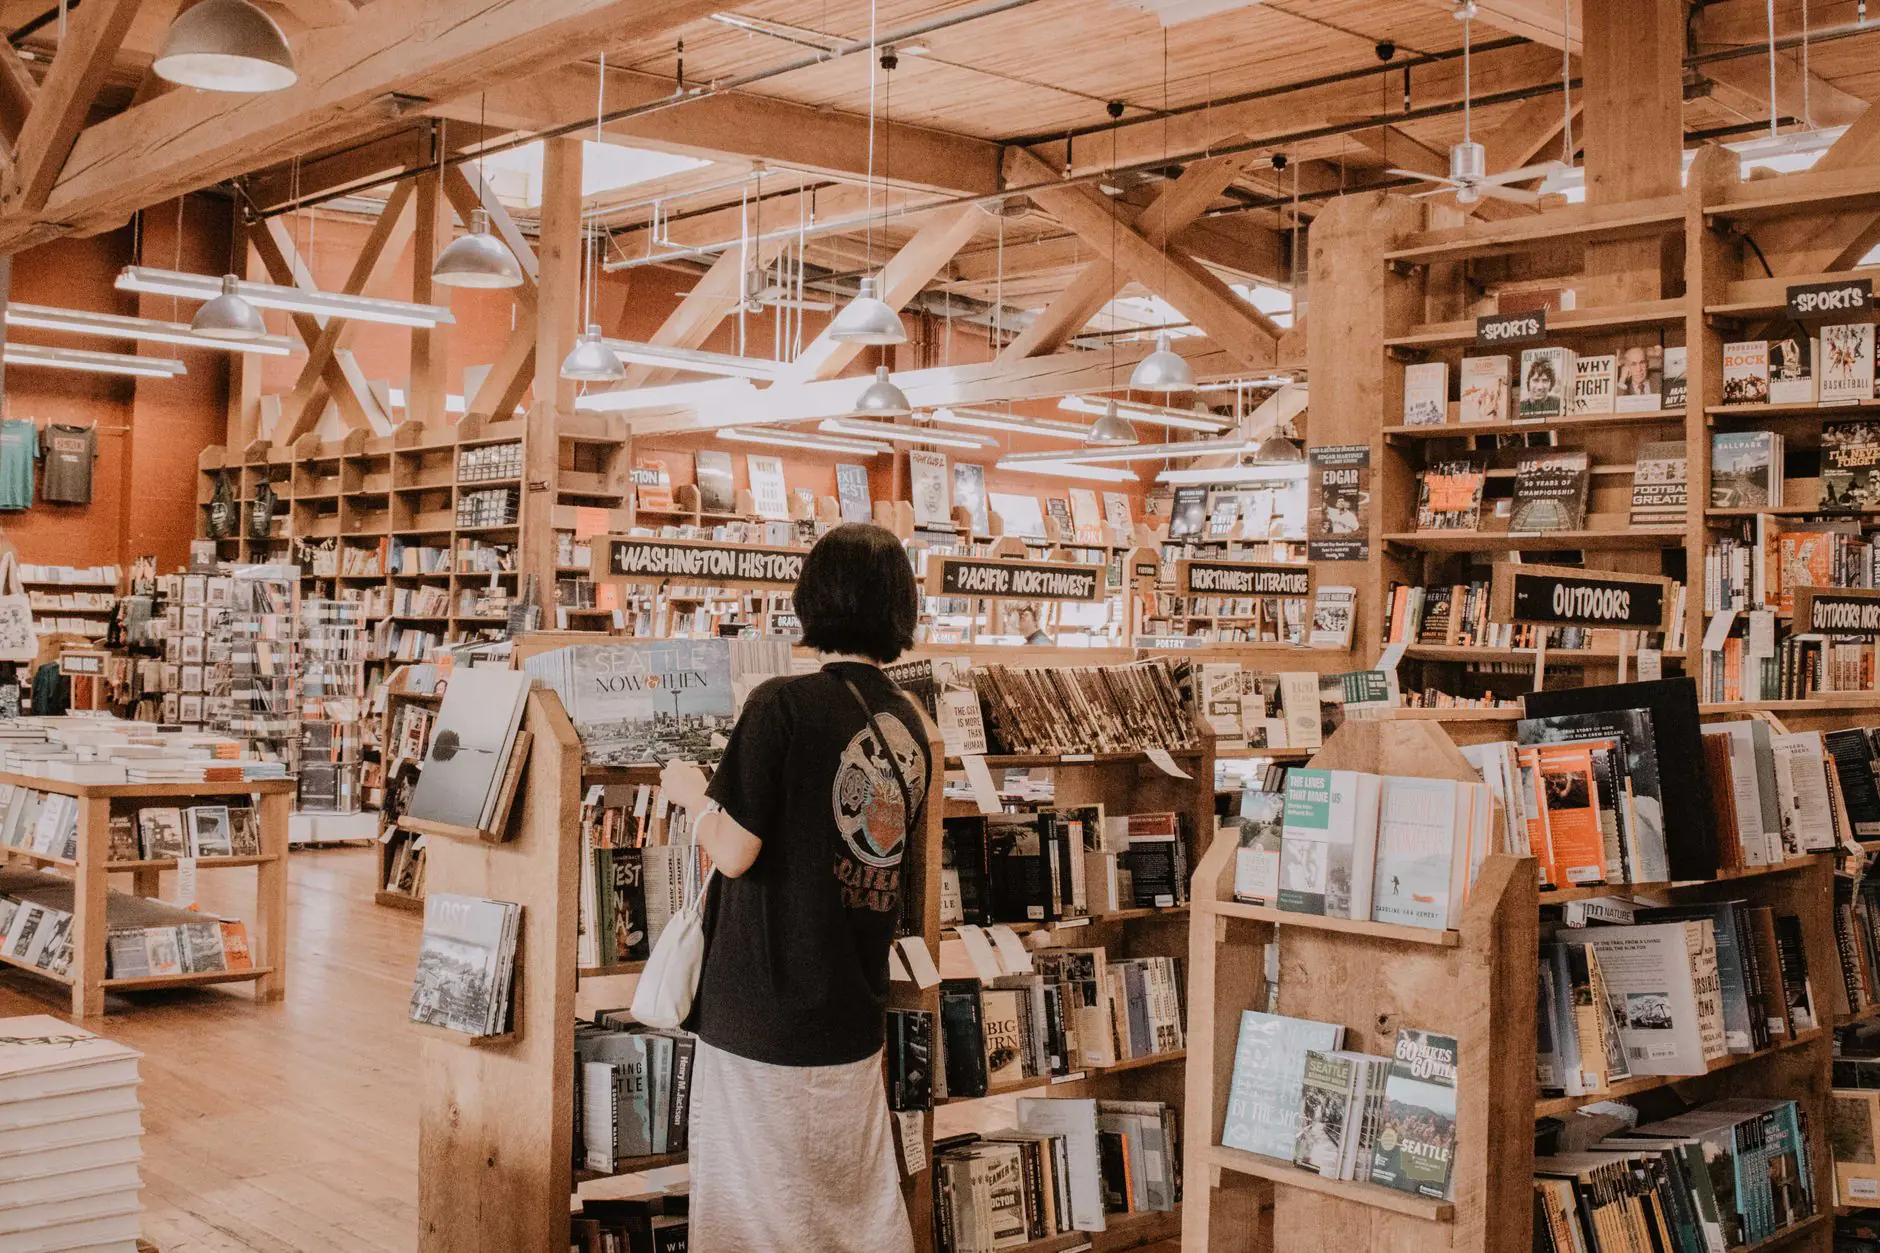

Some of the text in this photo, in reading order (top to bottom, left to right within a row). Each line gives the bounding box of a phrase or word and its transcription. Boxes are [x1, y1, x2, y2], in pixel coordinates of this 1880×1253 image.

[1797, 288, 1864, 312] SPORTS
[1485, 318, 1539, 340] SPORTS
[1577, 360, 1610, 373] WHY
[1724, 355, 1765, 367] ROCK
[1576, 378, 1610, 396] FIGHT
[1823, 379, 1869, 390] BASKETBALL
[1718, 441, 1762, 450] BALLPARK
[1851, 447, 1880, 458] NEVE
[1521, 459, 1580, 472] US OPEN
[1837, 457, 1876, 467] FORGET
[629, 469, 659, 484] TION
[1323, 469, 1359, 485] EDGAR
[620, 545, 735, 575] WASHINGTON
[958, 567, 1091, 597] PACIFIC NORTHWEST
[1191, 568, 1309, 593] NORTHWEST LITERATURE
[1553, 583, 1630, 620] OUTDOORS
[1814, 600, 1880, 629] OUTDOORS NOR
[1156, 639, 1185, 648] POETRY
[594, 649, 709, 676] SEATTLE
[596, 673, 641, 694] NOW
[661, 671, 708, 690] THEN
[954, 705, 979, 715] THE CITY
[957, 716, 981, 727] IS MORE
[968, 728, 983, 738] THAN
[963, 739, 984, 750] HUMAN
[1290, 775, 1303, 787] THE
[1289, 789, 1307, 801] THAT
[1308, 791, 1328, 802] MAKE
[1604, 907, 1633, 921] NATURE
[987, 1020, 1016, 1035] BIG
[1396, 1039, 1453, 1063] 60 HIKES
[677, 1056, 688, 1079] Henry
[1309, 1061, 1349, 1079] SEATTLE
[1411, 1058, 1431, 1079] 60
[674, 1093, 685, 1126] Jackson
[1400, 1138, 1448, 1161] SEATTLE
